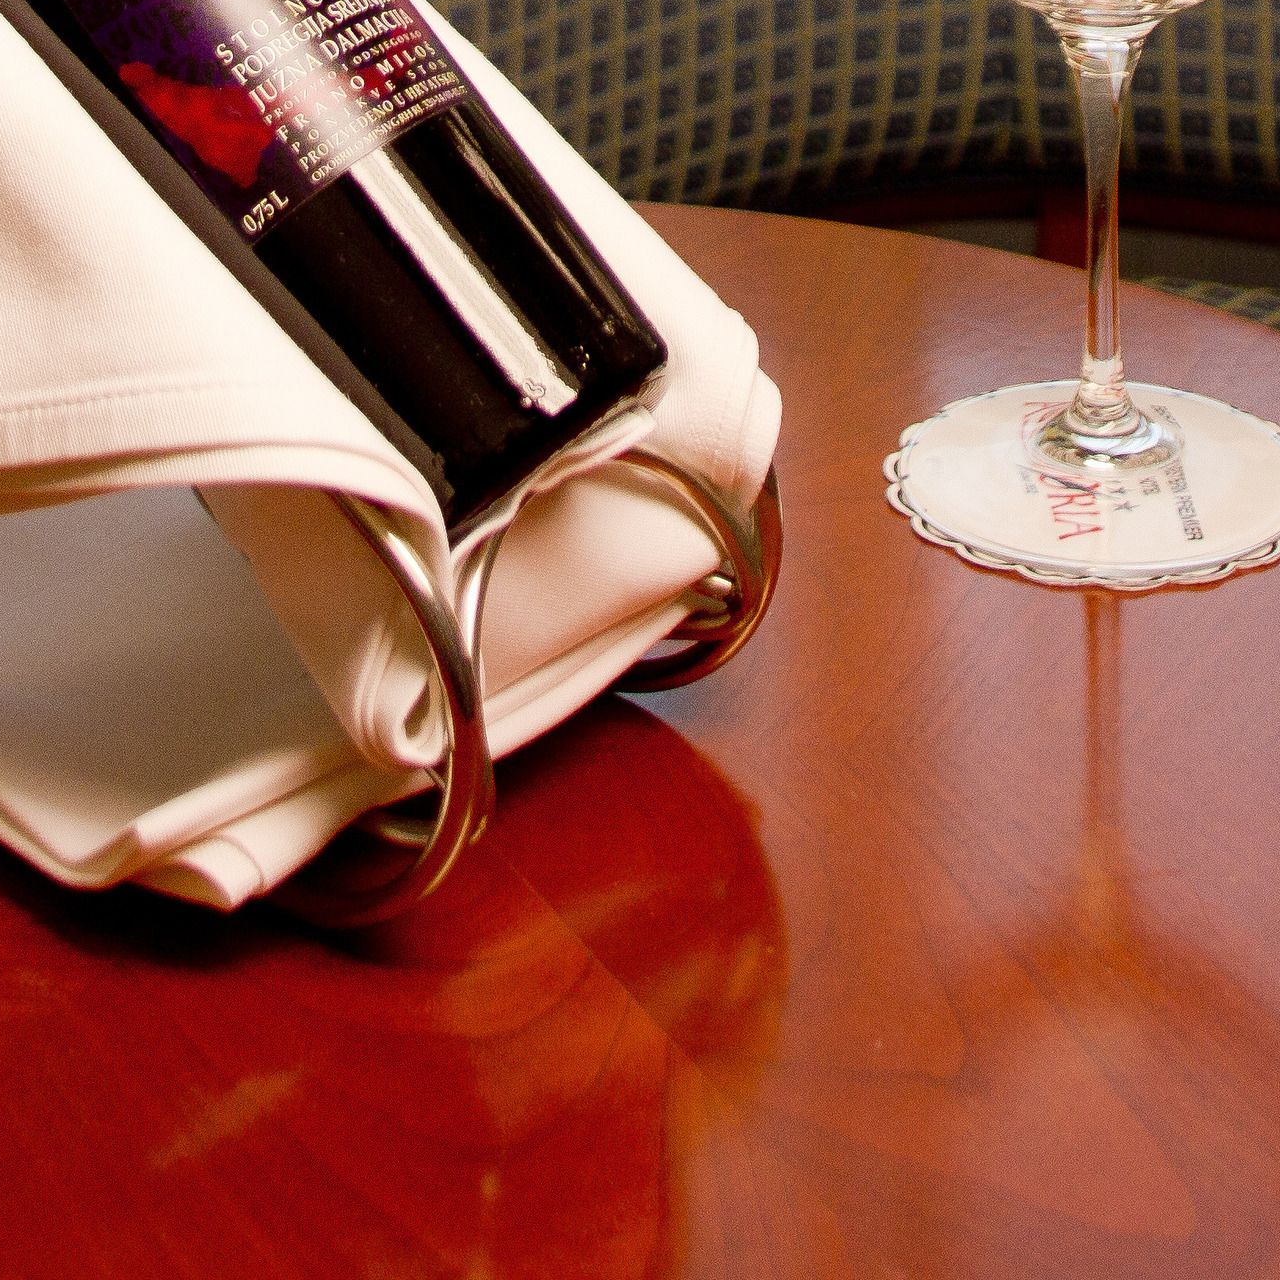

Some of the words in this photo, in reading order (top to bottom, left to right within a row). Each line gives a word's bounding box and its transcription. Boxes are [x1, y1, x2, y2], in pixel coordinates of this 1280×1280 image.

[232, 13, 334, 86] PODREGIJA
[248, 51, 324, 114] JUŽNA
[321, 7, 414, 62] DALMACIJA
[276, 75, 366, 142] FRANO
[393, 93, 406, 108] U
[243, 197, 275, 232] 0,75
[269, 190, 289, 211] L
